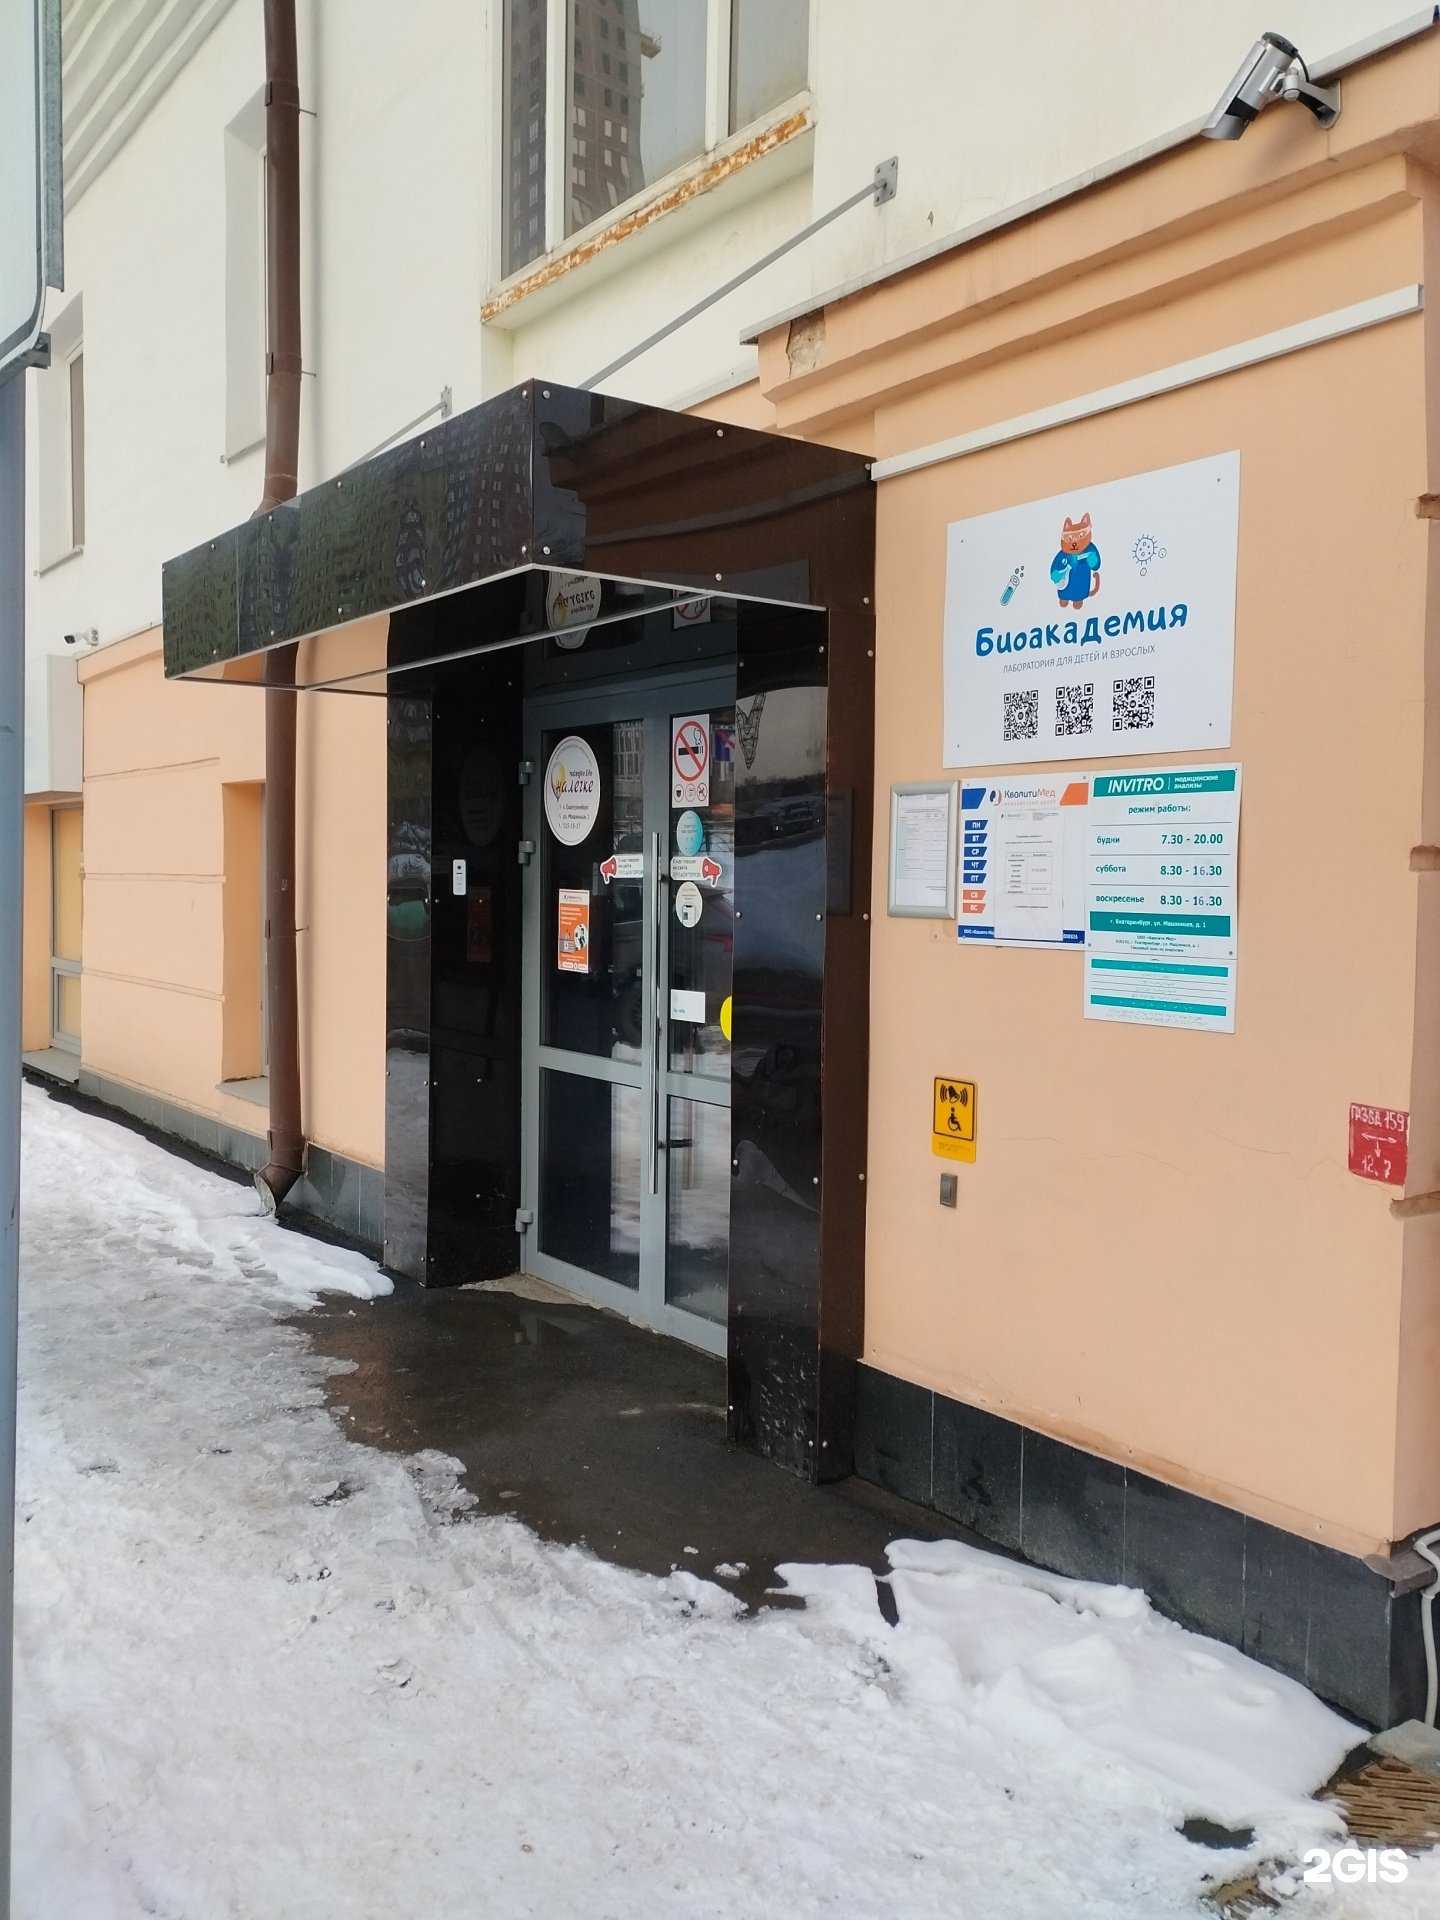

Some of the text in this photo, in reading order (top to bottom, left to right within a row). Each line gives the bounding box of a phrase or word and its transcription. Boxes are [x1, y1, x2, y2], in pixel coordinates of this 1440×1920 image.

[976, 604, 1188, 657] Биоакадемия
[1003, 645, 1155, 673] ЛАБОРАТОРИЯ ДЛЯ ДЕТЕЙ И ВЗРОСЛЫХ
[1107, 777, 1165, 794] INVITRO
[1174, 782, 1203, 790] анализы
[1128, 803, 1192, 815] режим работы:
[1096, 835, 1120, 846] будни
[1161, 834, 1183, 845] 7.30
[1194, 833, 1224, 845] 20.00
[1095, 864, 1127, 874] суббота
[1160, 865, 1183, 876] 8.30
[1192, 865, 1222, 876] 16.30
[1096, 895, 1145, 904] воскресенье
[1160, 895, 1182, 906] 8.30
[1192, 896, 1223, 907] 16.30
[1384, 1111, 1406, 1132] 159
